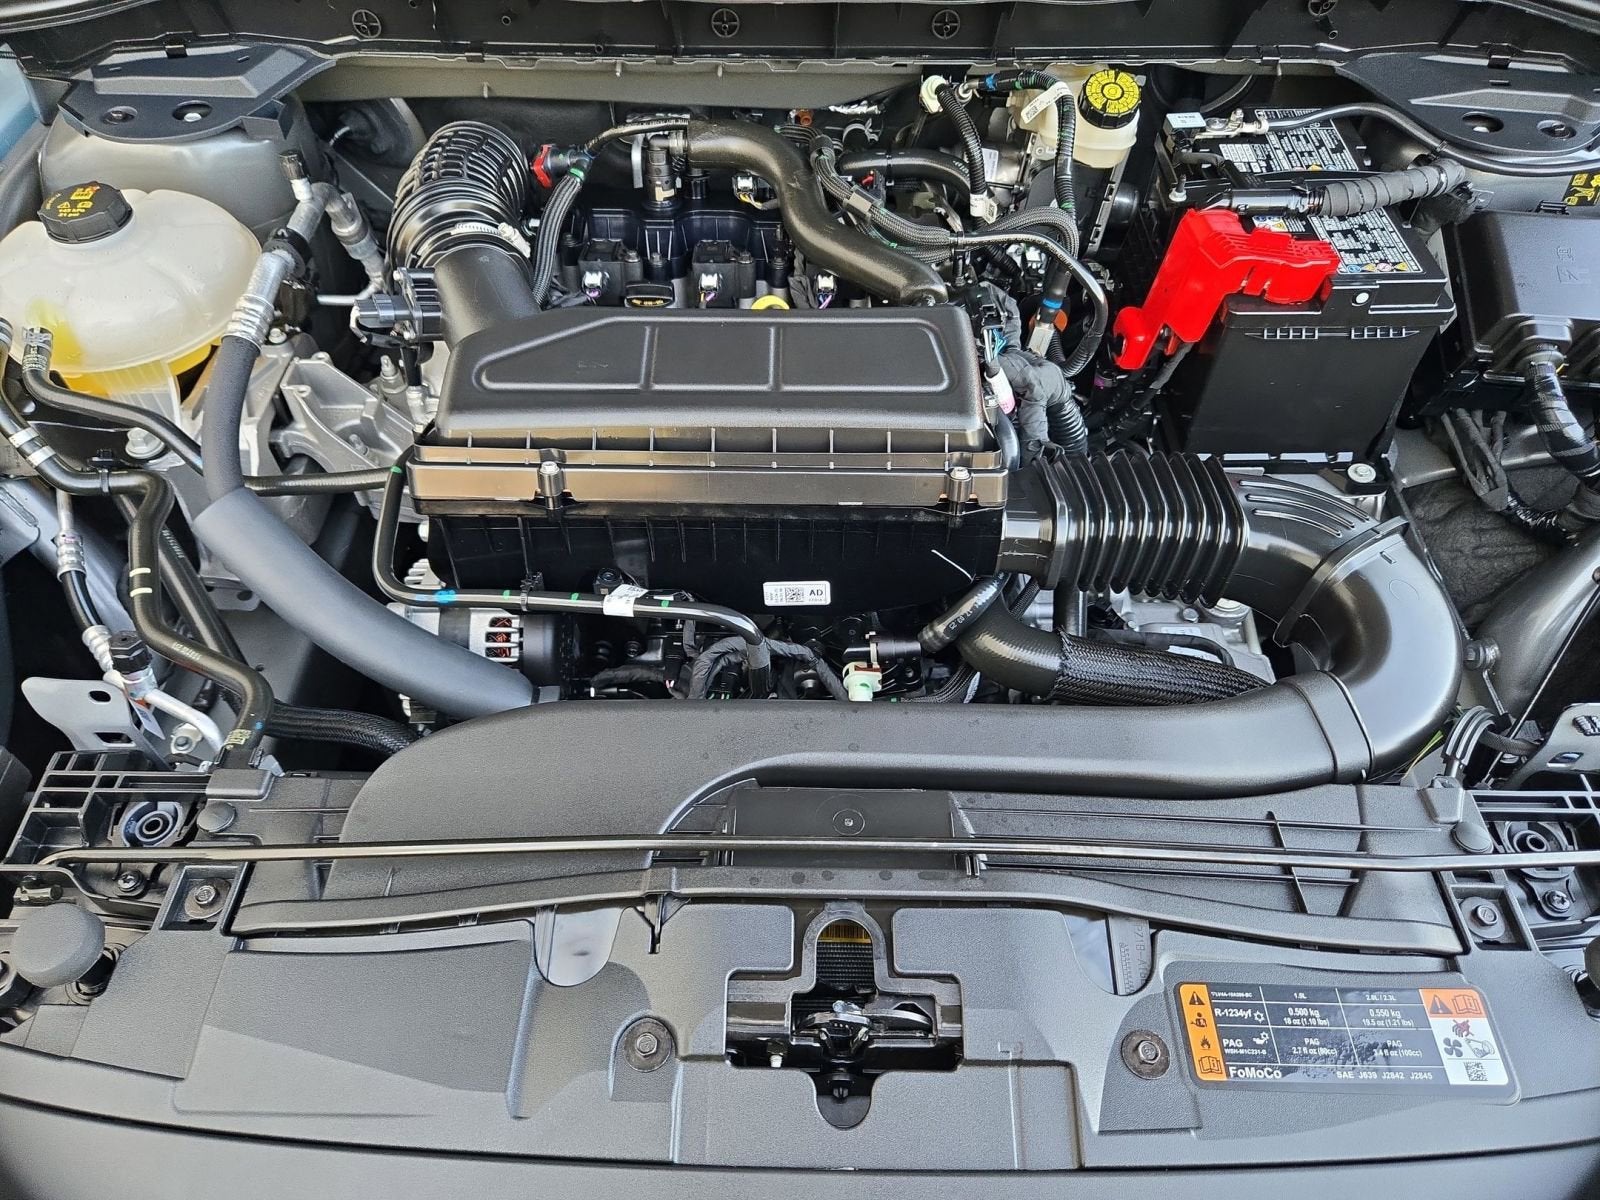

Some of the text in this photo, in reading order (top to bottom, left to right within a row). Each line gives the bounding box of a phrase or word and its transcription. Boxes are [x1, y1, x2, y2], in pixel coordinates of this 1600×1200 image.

[1214, 1008, 1252, 1019] R-1234yf
[1288, 1007, 1320, 1018] 0.500 kg
[1369, 1008, 1401, 1019] 0.550 kg
[1317, 1018, 1330, 1027] lbs)
[1401, 1019, 1414, 1028] lbs)
[1222, 1038, 1243, 1048] PAG
[1304, 1038, 1320, 1046] PAG
[1386, 1040, 1403, 1048] PAG
[1229, 1066, 1282, 1079] FoMoCo
[1336, 1071, 1433, 1080] SAE J639 J2842 J2845
